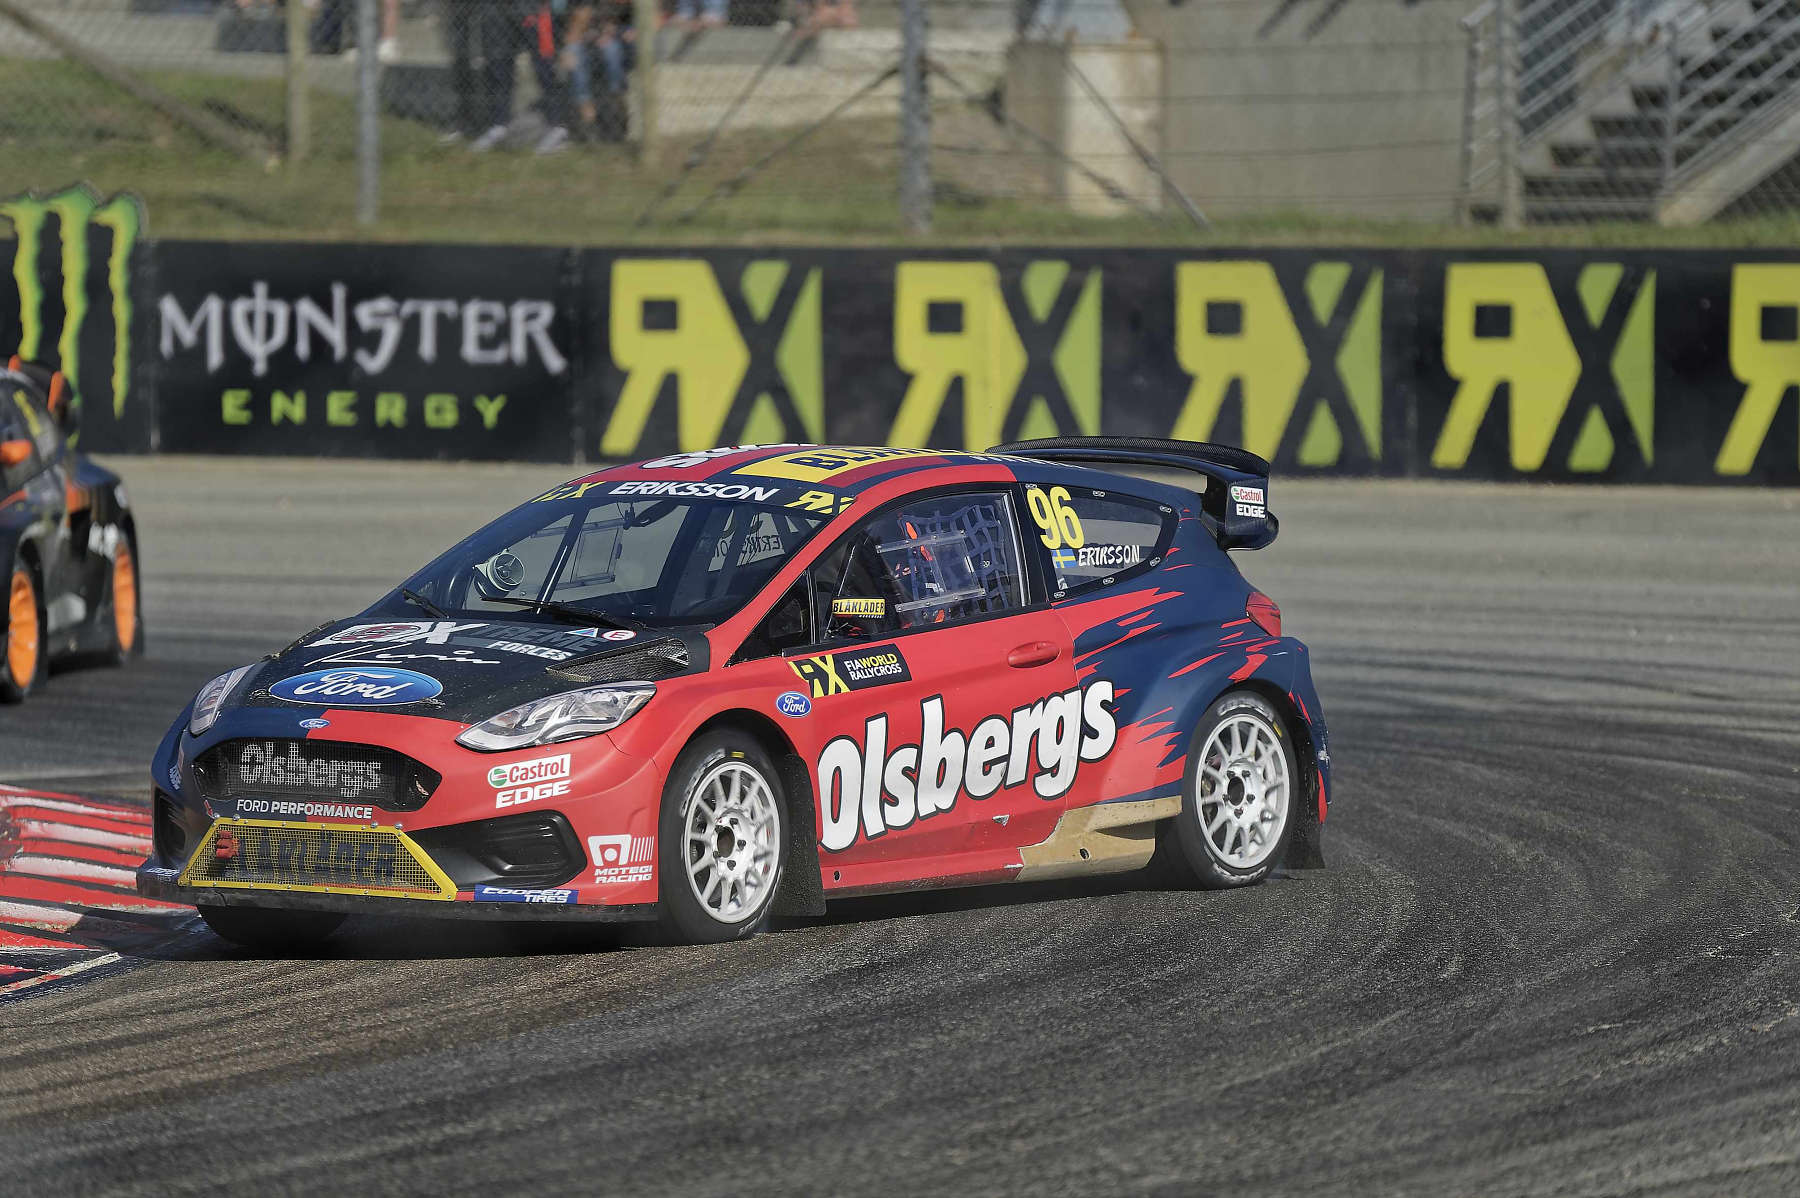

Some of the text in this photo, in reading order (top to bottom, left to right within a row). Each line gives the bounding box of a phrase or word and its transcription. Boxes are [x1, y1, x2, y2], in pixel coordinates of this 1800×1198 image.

[158, 281, 568, 375] MONSTER
[221, 389, 507, 429] ENERGY
[608, 481, 781, 502] ERIKSSON
[1239, 488, 1263, 502] Castrol
[1026, 486, 1085, 550] 96
[1236, 504, 1266, 518] EDGE
[1078, 545, 1140, 567] ERIKSSON
[486, 641, 578, 661] FORCES
[849, 663, 902, 681] RALLYCROSS
[293, 671, 414, 699] Ford
[783, 695, 806, 713] Ford
[239, 742, 381, 797] Olsbergs
[509, 758, 566, 783] Castrol
[818, 681, 1117, 854] Olsbergs
[495, 780, 572, 809] EDGE
[236, 799, 373, 819] FORD PERFORMANCE
[594, 865, 652, 876] MOTEGI
[595, 873, 652, 884] RACING
[482, 887, 572, 896] COOPER
[524, 894, 568, 903] TIRES
